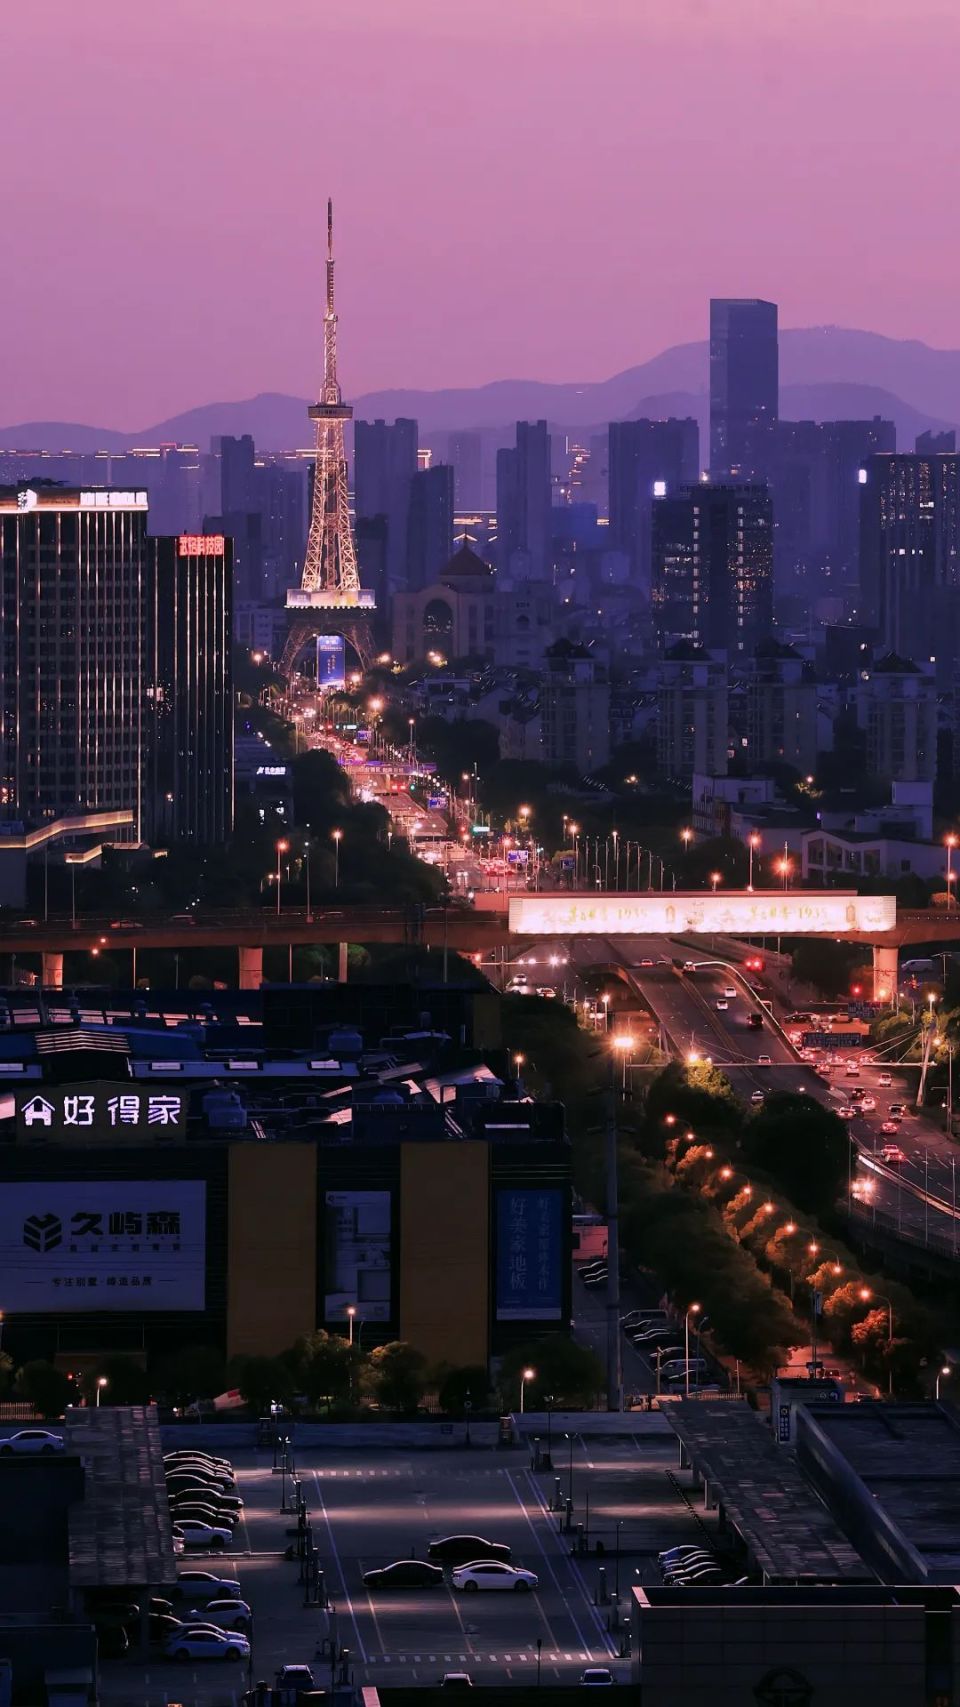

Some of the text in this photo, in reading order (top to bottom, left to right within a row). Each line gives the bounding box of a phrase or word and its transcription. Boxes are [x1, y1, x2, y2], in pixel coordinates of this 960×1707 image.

[63, 1094, 182, 1126] 好得家
[70, 1211, 181, 1235] 久屿森
